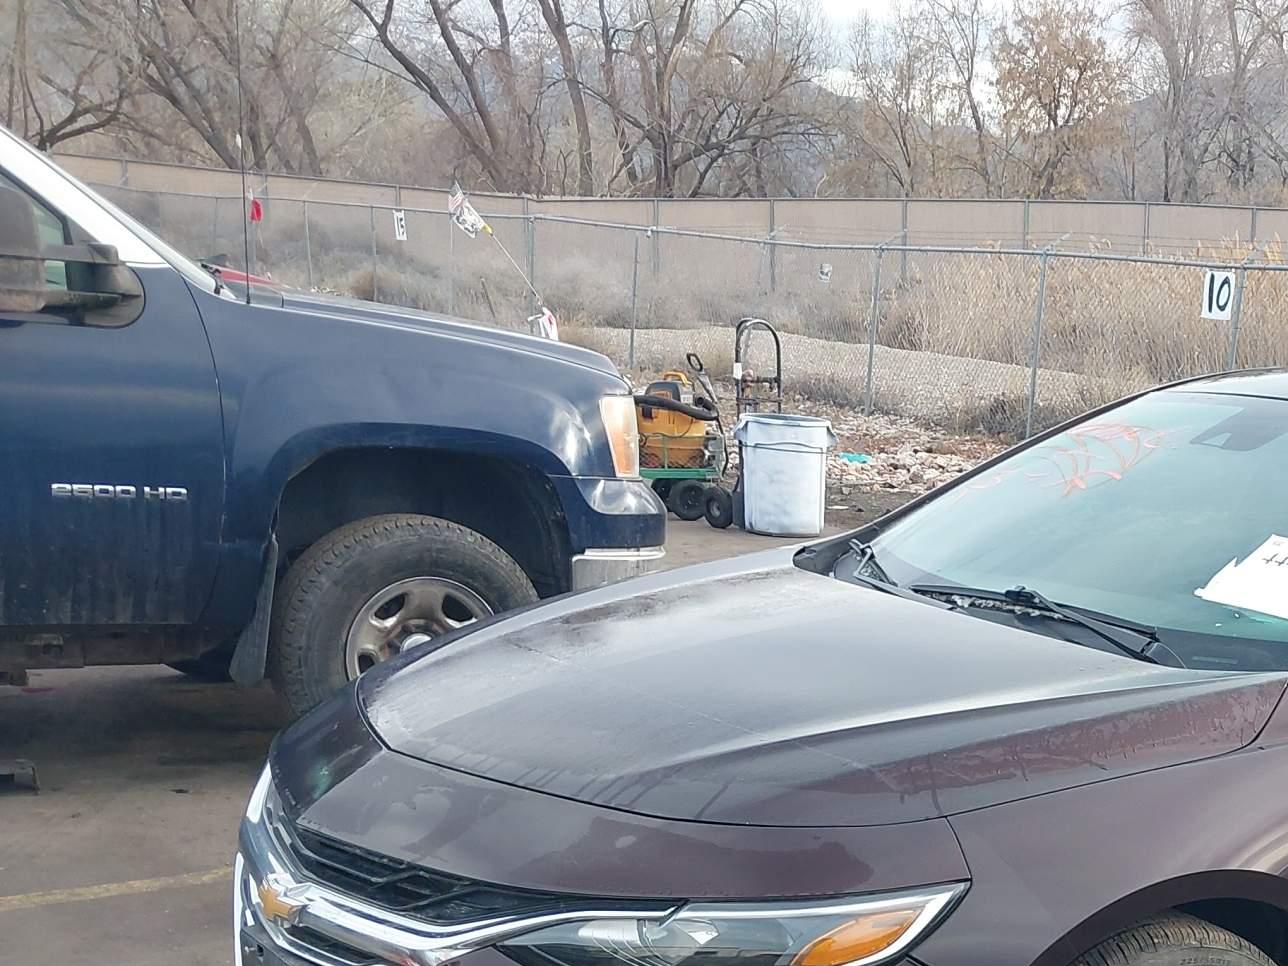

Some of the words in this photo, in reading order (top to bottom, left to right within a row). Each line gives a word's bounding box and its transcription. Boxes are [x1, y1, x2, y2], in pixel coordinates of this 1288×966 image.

[1208, 272, 1231, 313] 10
[51, 483, 137, 499] 2500
[143, 486, 188, 501] HD
